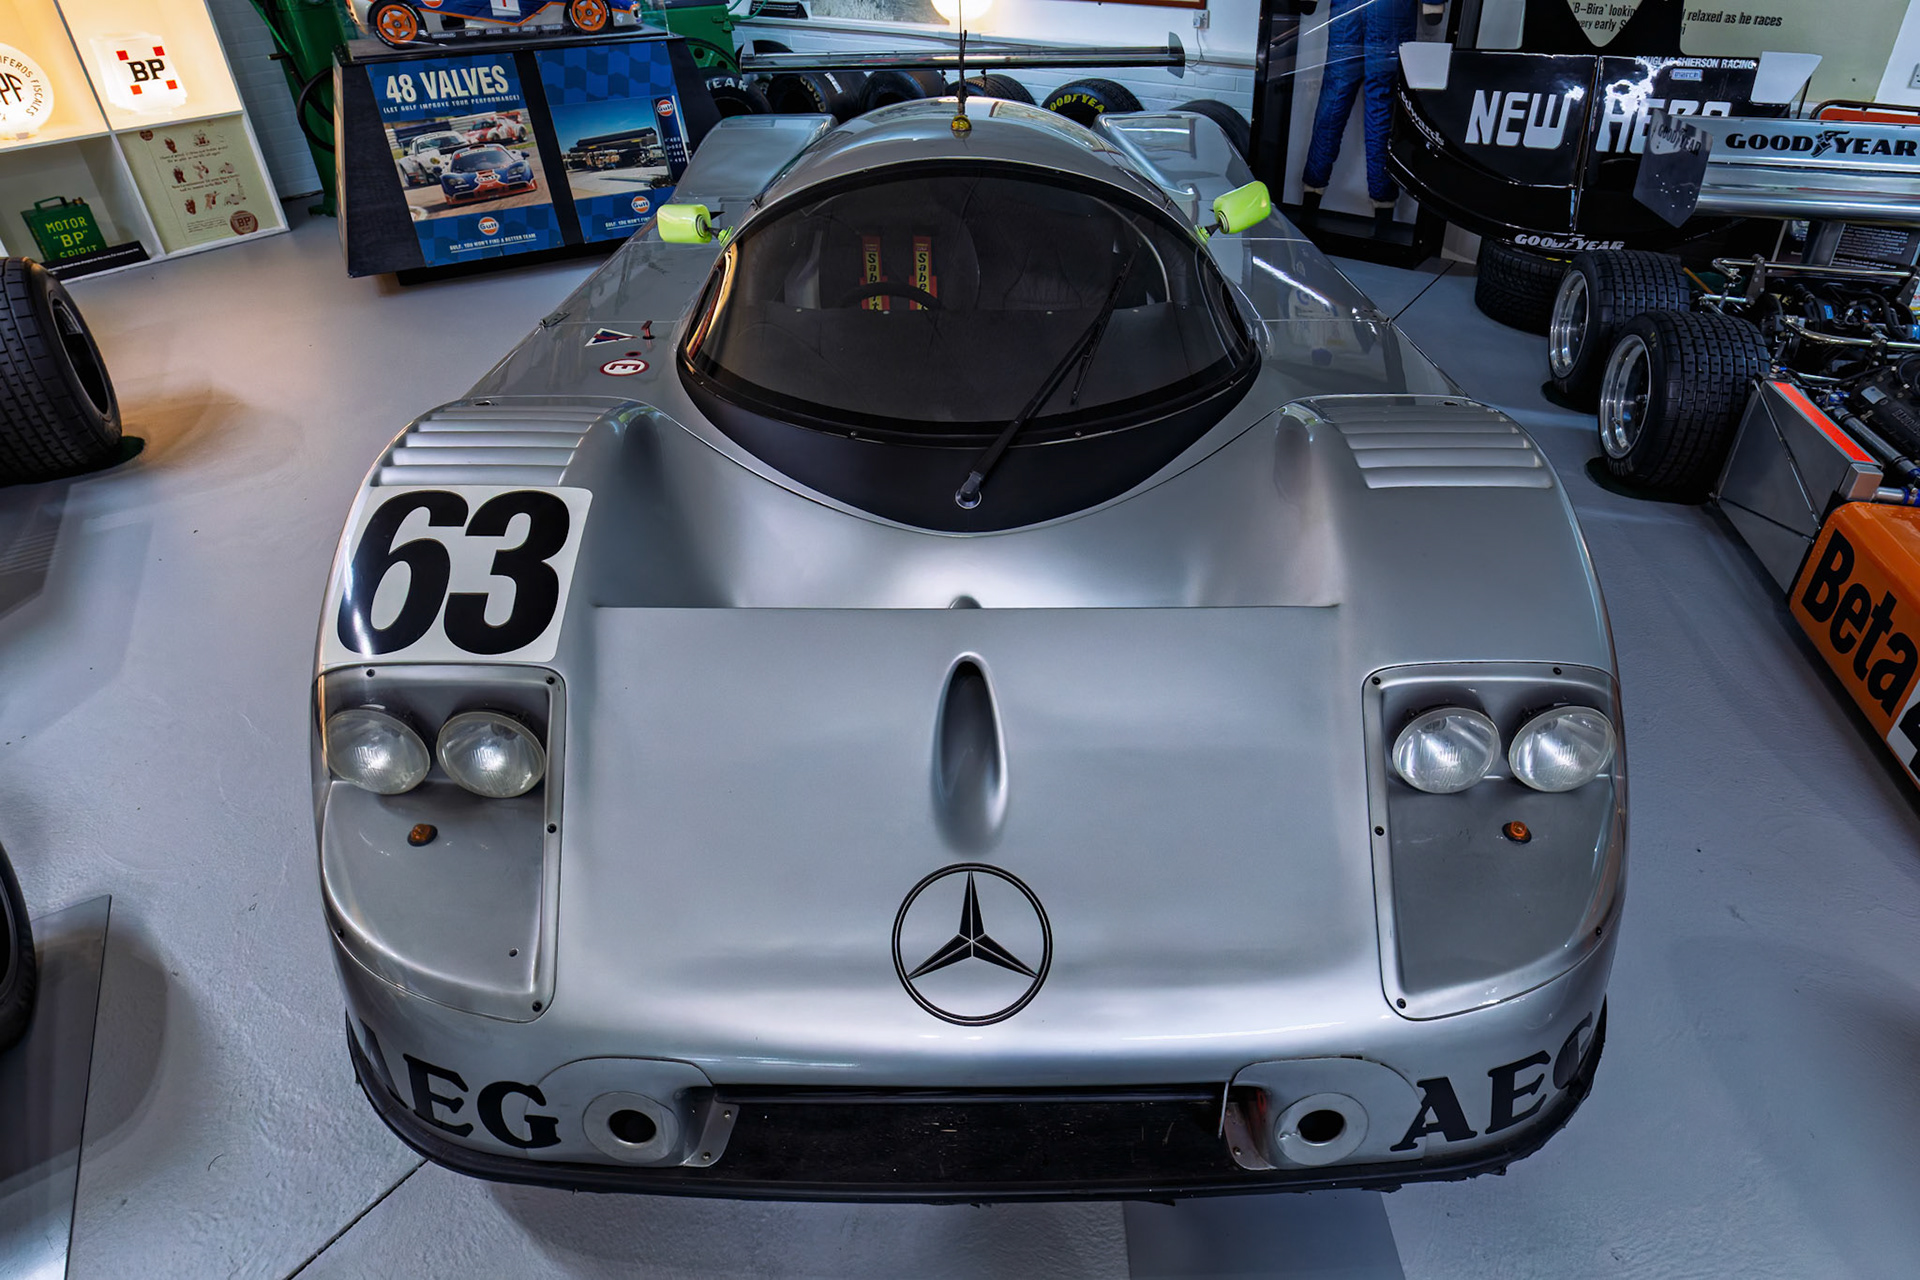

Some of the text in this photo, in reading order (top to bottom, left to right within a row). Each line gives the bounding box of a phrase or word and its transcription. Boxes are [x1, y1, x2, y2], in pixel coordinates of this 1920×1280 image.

[1609, 4, 1637, 17] lookin
[1687, 11, 1722, 23] relaxed
[1724, 15, 1737, 23] as
[1738, 13, 1752, 24] he
[1753, 15, 1783, 27] races
[1594, 19, 1618, 32] early
[127, 58, 166, 83] BP
[1721, 59, 1754, 70] RACING
[386, 65, 510, 104] 48 VALVES
[383, 105, 398, 114] (LET
[420, 101, 450, 110] IMPROVE
[452, 99, 469, 107] YOUR
[471, 94, 520, 105] PERFORMANCE)
[1464, 89, 1732, 154] NEW HE
[45, 216, 88, 234] MOTOR
[236, 216, 251, 227] BP
[480, 222, 497, 230] Gulf
[474, 240, 489, 248] WON'T
[505, 235, 523, 243] BETTER
[337, 489, 570, 655] 63
[1801, 528, 1919, 718] Beta
